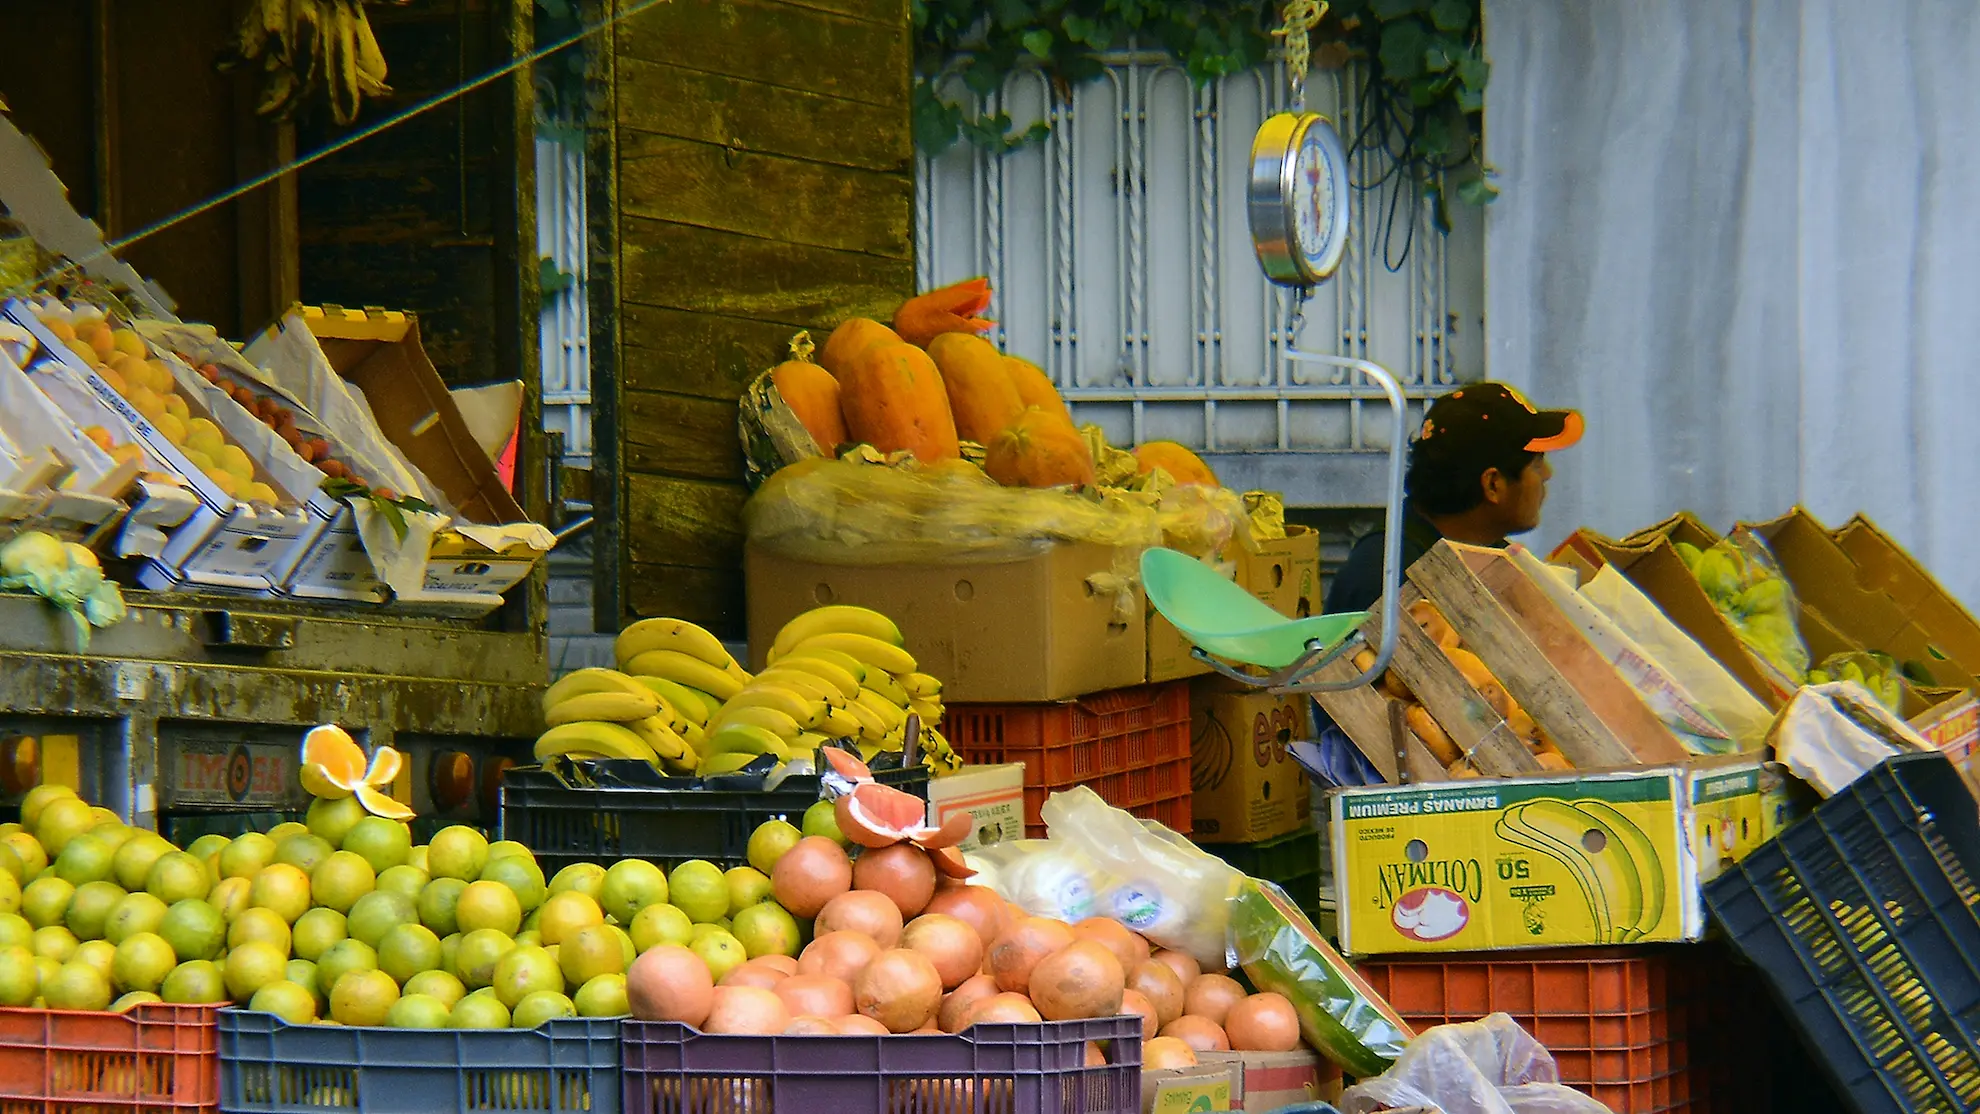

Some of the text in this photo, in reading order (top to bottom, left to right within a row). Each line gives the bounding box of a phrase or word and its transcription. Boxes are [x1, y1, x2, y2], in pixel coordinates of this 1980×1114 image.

[136, 421, 153, 438] DE
[1348, 795, 1498, 818] BANANAS PREMIUM
[1498, 859, 1530, 880] 50
[1378, 858, 1482, 908] COLIMAN
